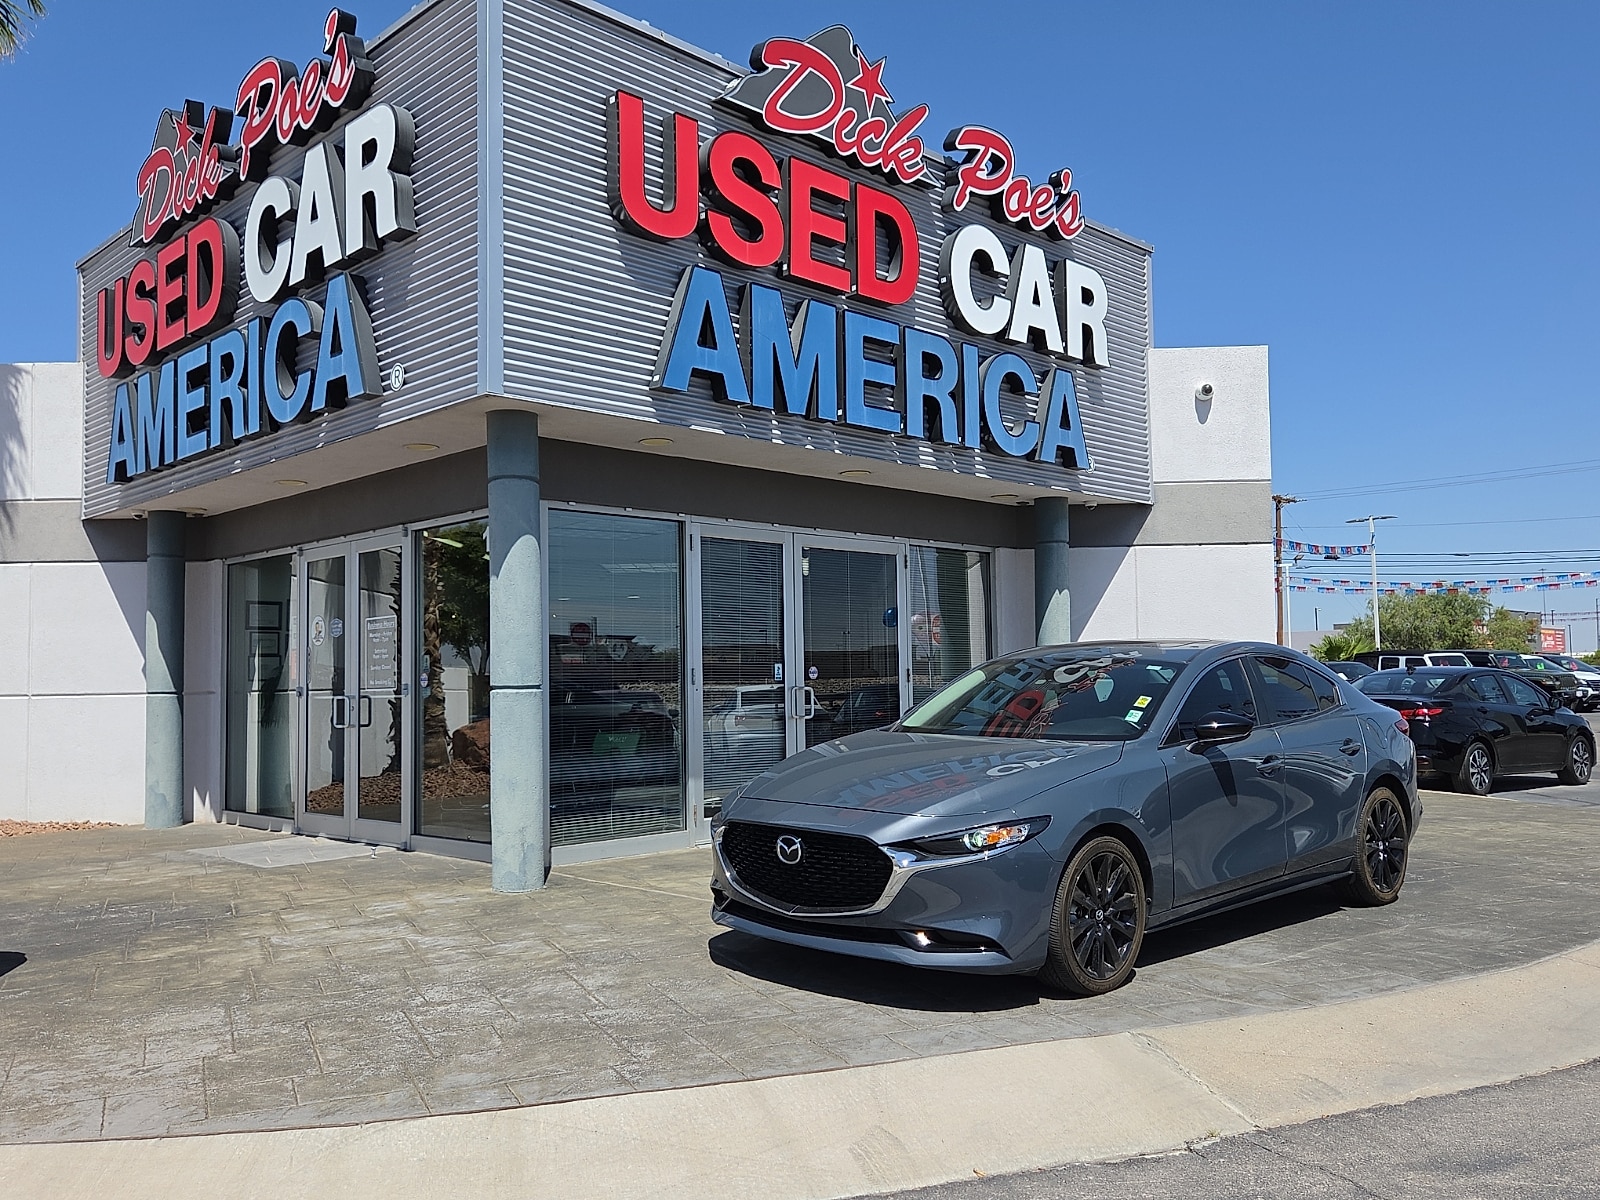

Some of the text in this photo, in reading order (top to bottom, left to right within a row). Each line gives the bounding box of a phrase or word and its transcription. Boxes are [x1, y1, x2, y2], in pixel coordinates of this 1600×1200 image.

[136, 7, 356, 243] Dick Poe's
[617, 89, 1110, 368] USED CAR
[761, 36, 1086, 240] Dick Poe's
[97, 102, 399, 379] USED CAR
[105, 271, 366, 485] AMERICA
[661, 265, 1090, 470] AMERICA
